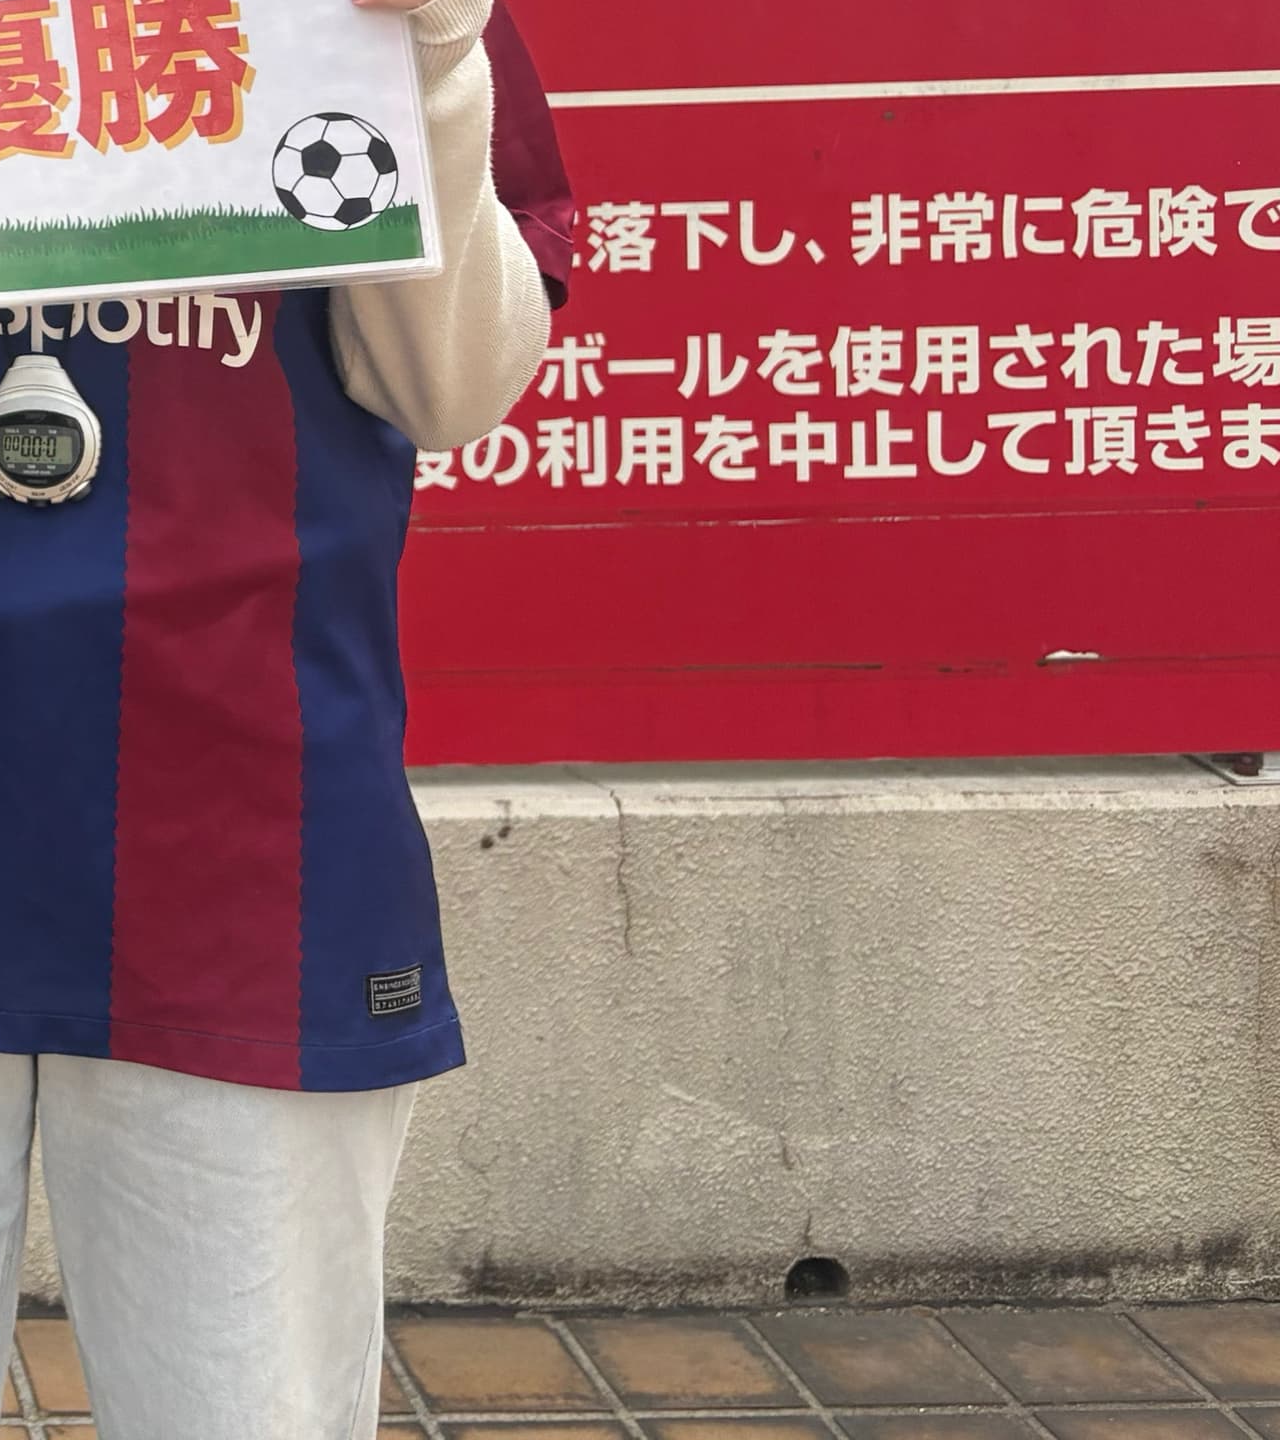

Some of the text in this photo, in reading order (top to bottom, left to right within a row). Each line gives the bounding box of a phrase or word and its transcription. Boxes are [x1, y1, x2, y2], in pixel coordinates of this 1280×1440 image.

[571, 185, 1280, 273] 落下し、非常に危険で
[537, 316, 1280, 401] ボールを使用された場
